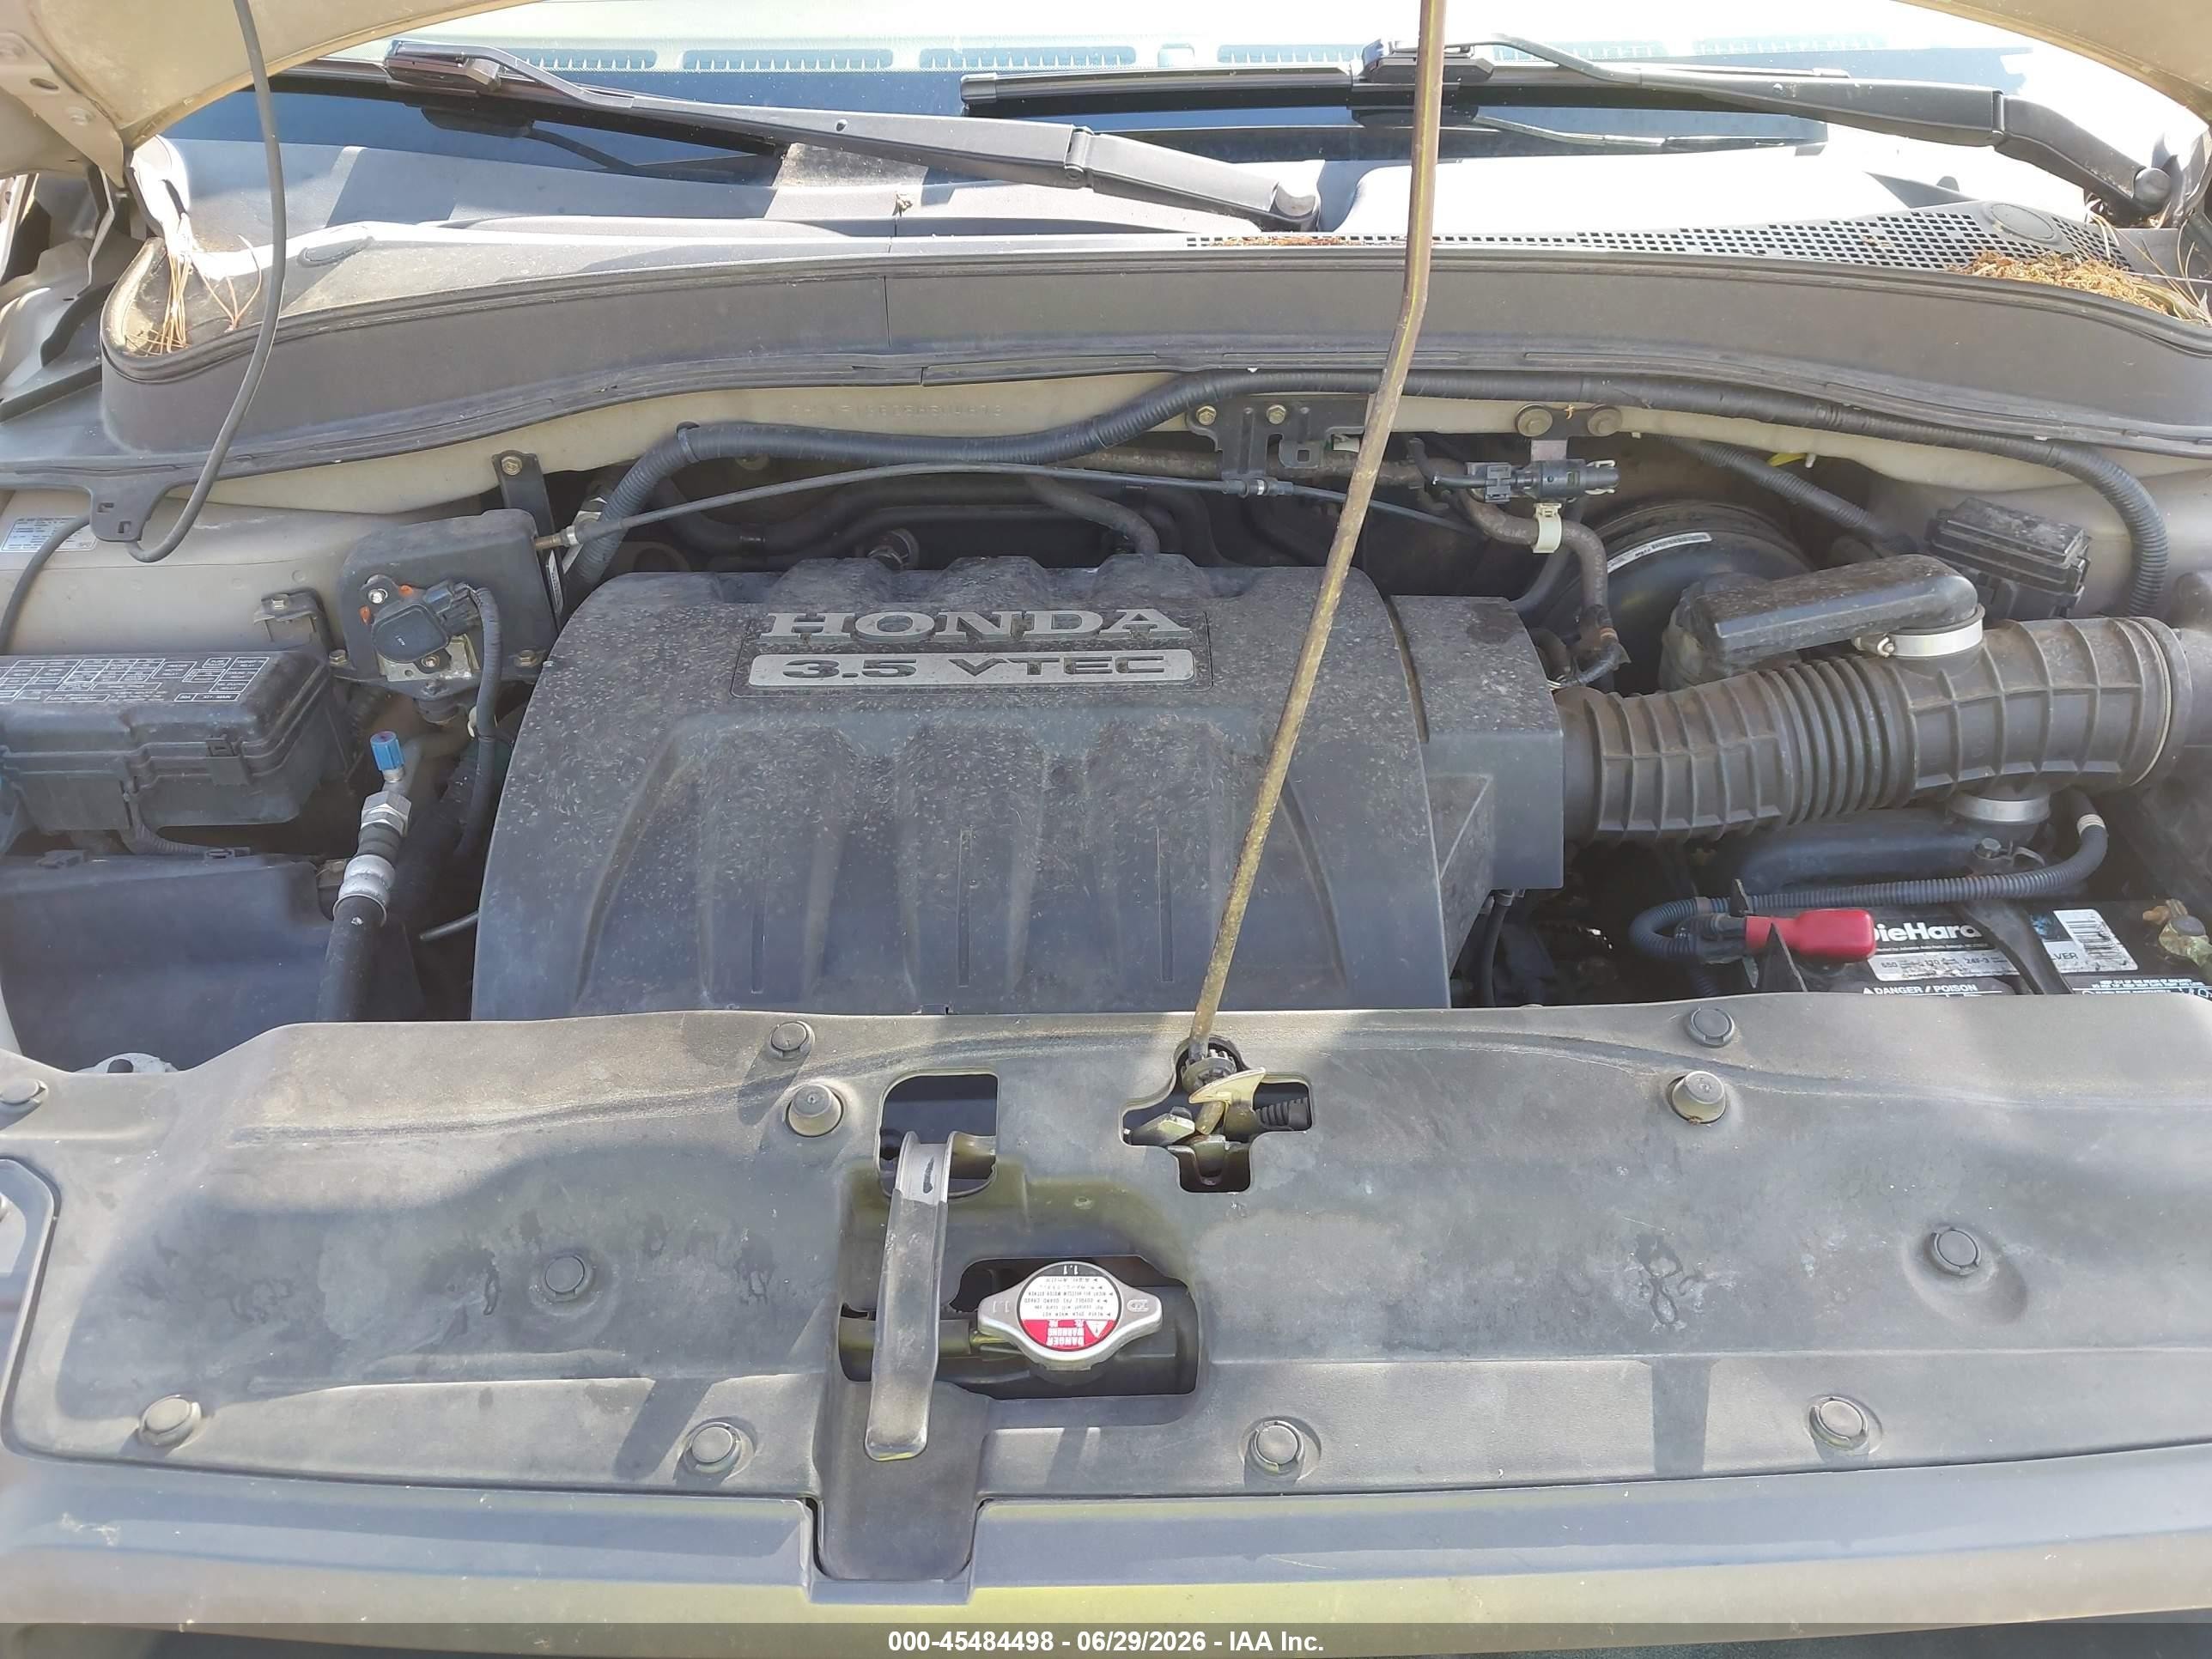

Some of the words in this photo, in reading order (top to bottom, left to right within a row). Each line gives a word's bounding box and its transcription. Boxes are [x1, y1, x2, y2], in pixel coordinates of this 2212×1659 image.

[760, 607, 1192, 641] HONDA
[783, 658, 918, 678] 3.5
[949, 655, 1165, 677] VTEC
[1874, 986, 1923, 994] DANGER
[1933, 983, 1979, 993] POISON
[1063, 1265, 1079, 1276] 1.1
[1046, 1336, 1085, 1346] DANGER
